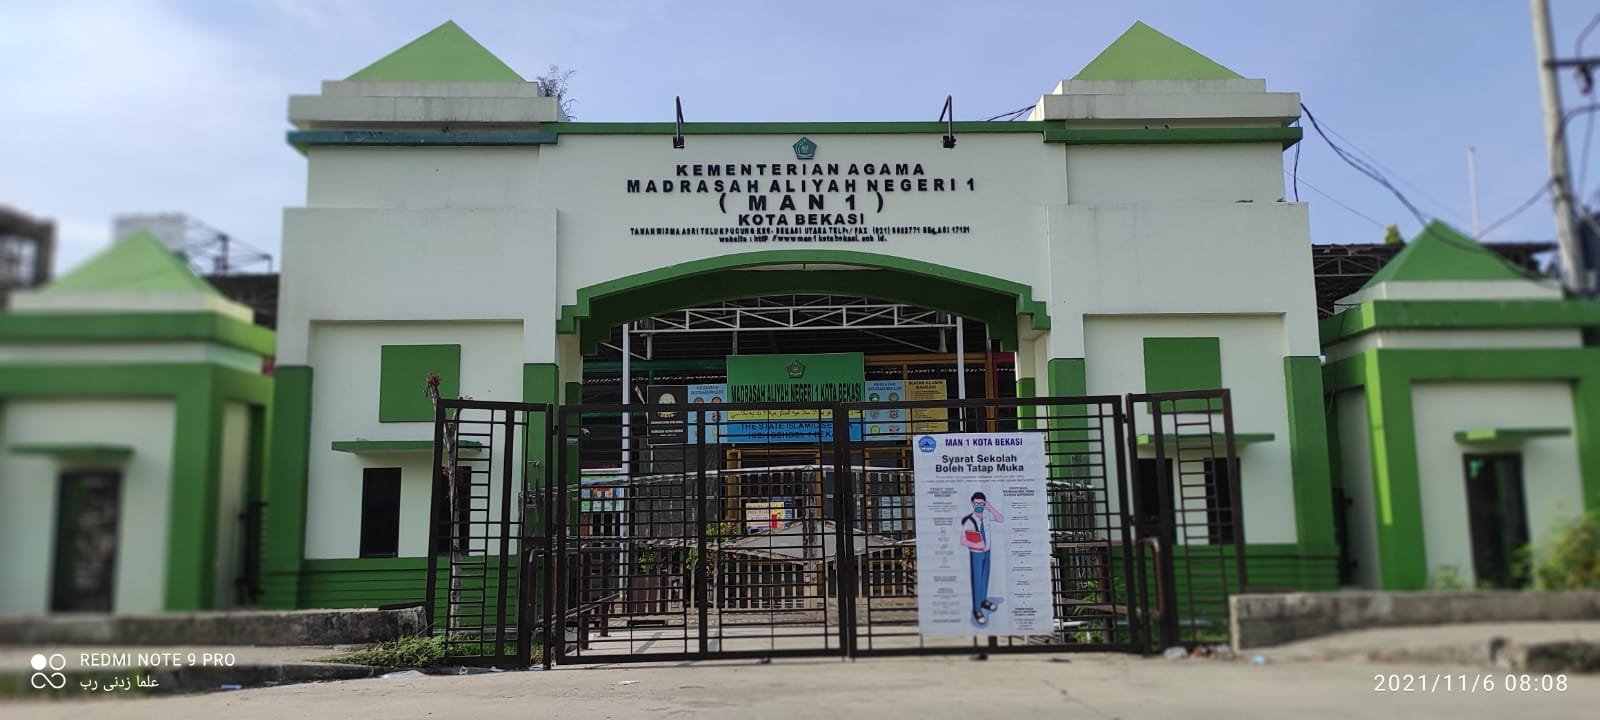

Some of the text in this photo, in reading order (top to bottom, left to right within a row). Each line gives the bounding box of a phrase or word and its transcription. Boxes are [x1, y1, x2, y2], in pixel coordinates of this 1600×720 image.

[676, 163, 924, 176] KEMENTERIAN AGAMA
[627, 178, 975, 193] MADRASAH ALIYAH NEGERI 1
[738, 213, 864, 226] KOTA BEKASI
[731, 382, 860, 402] MADRASAH ALIYAH NEGERI 1 KOTA BEKASI
[945, 438, 1023, 447] MAN 1 KOTA BEKASI
[942, 454, 1017, 465] Syarat Sekolah
[936, 463, 1024, 474] Boleh Tatap Muka
